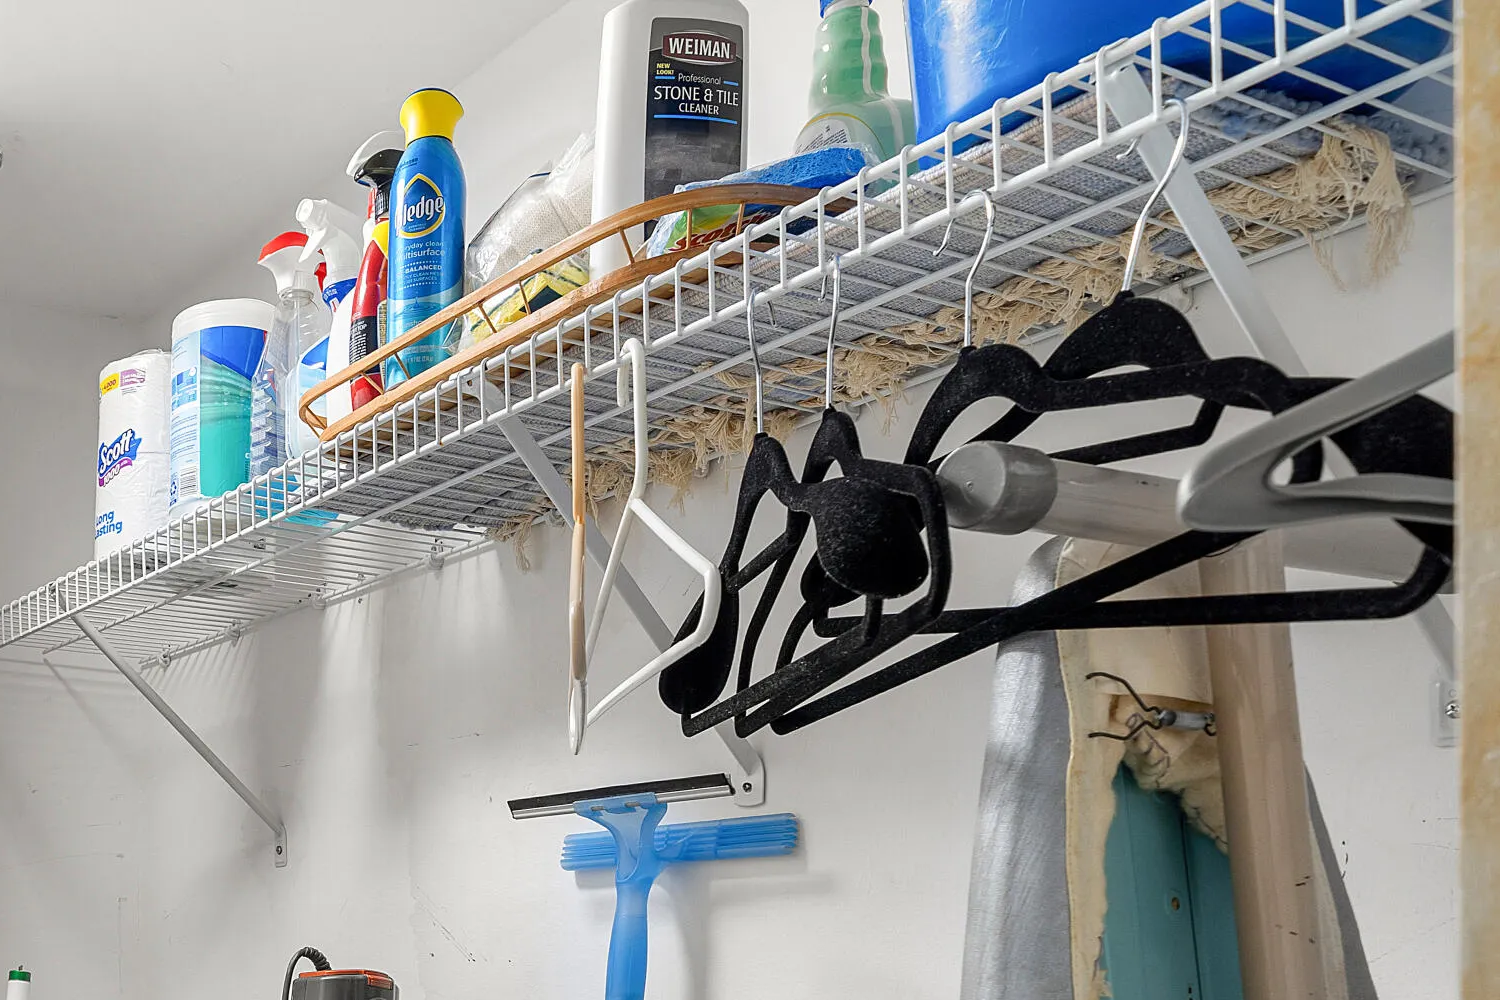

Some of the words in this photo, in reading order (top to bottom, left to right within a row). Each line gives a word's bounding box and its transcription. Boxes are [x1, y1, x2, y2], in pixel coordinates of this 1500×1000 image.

[669, 38, 730, 59] WEIMAN
[678, 73, 721, 85] Professional
[654, 86, 700, 101] STONE
[704, 88, 713, 102] &
[716, 89, 739, 106] TILE
[678, 103, 719, 115] CLEANER
[99, 429, 133, 474] Scott
